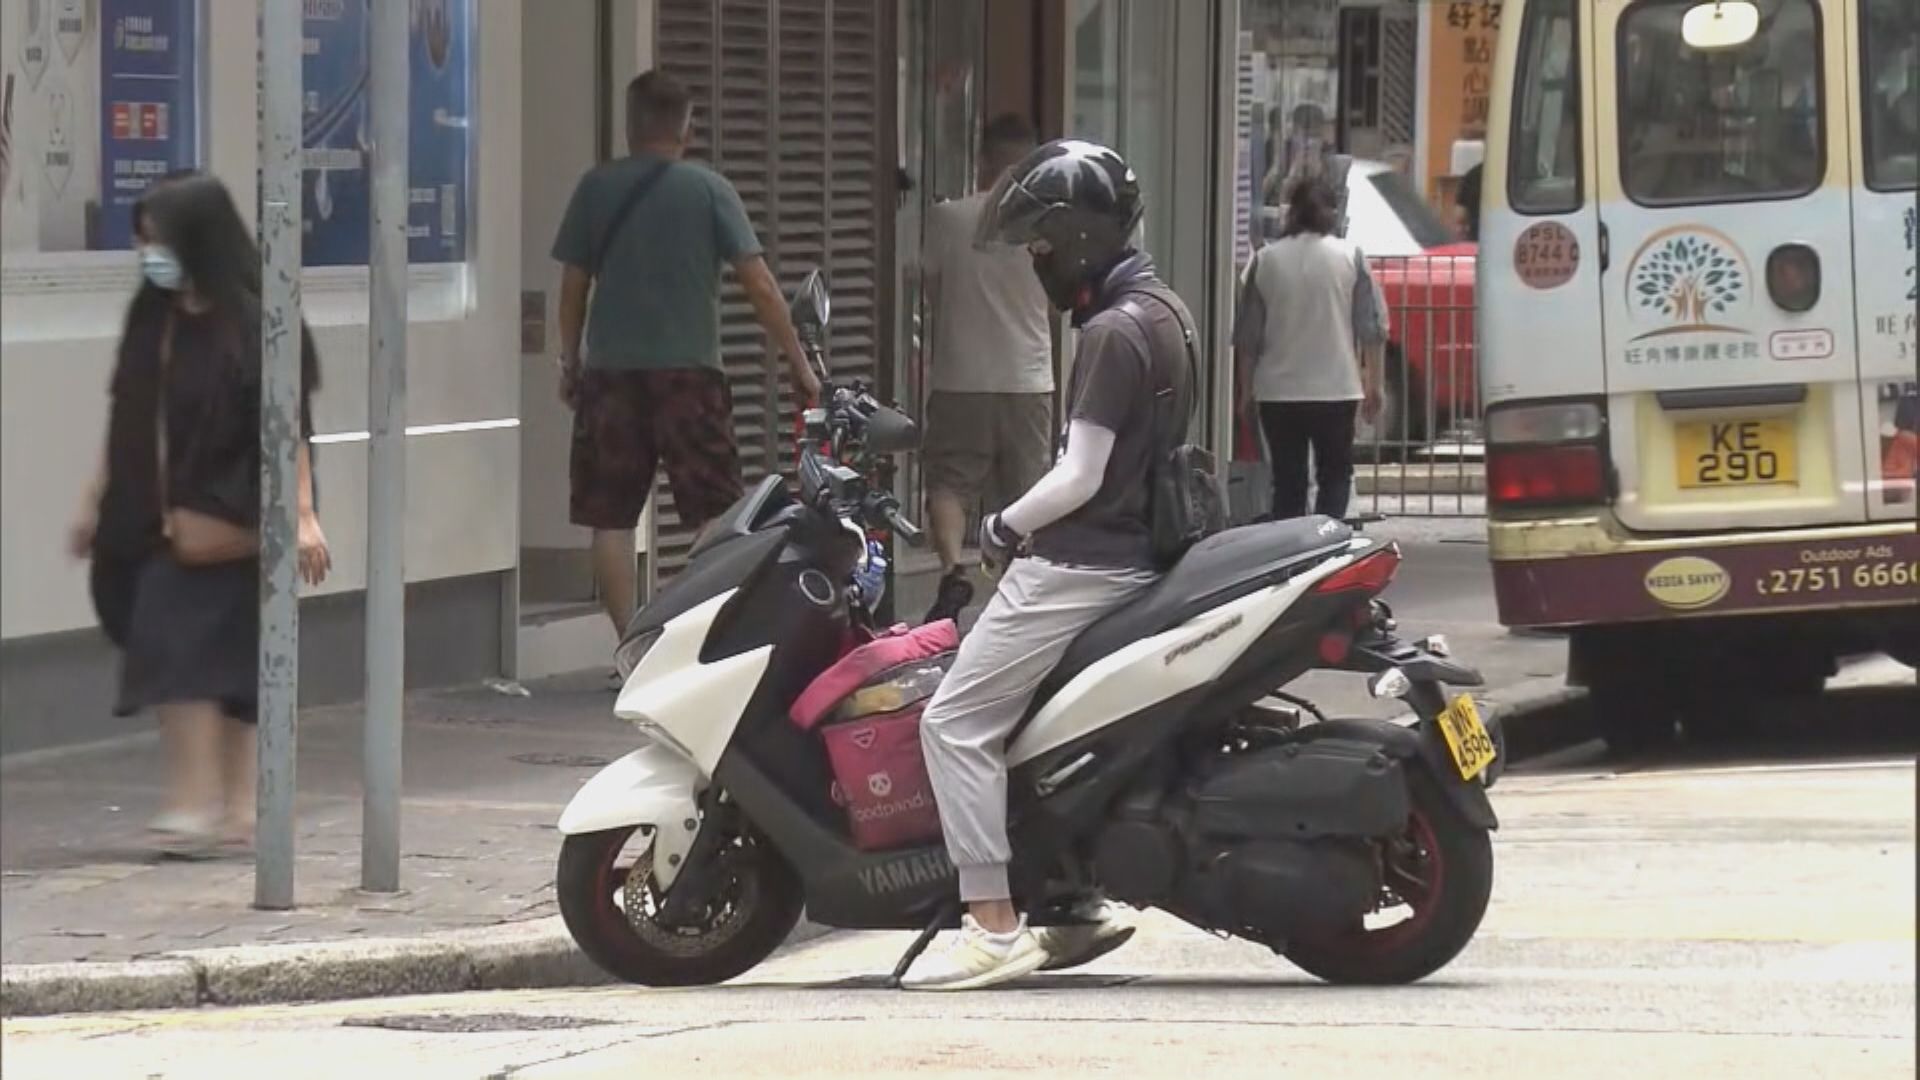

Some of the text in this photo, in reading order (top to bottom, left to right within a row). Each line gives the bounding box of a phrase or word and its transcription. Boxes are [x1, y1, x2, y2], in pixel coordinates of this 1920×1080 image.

[1530, 226, 1566, 241] PSL
[1711, 421, 1761, 453] KE
[1698, 451, 1777, 482] 290
[1800, 545, 1893, 563] Outdoor Ads
[1771, 567, 1840, 593] 2751
[849, 791, 934, 822] oodpand
